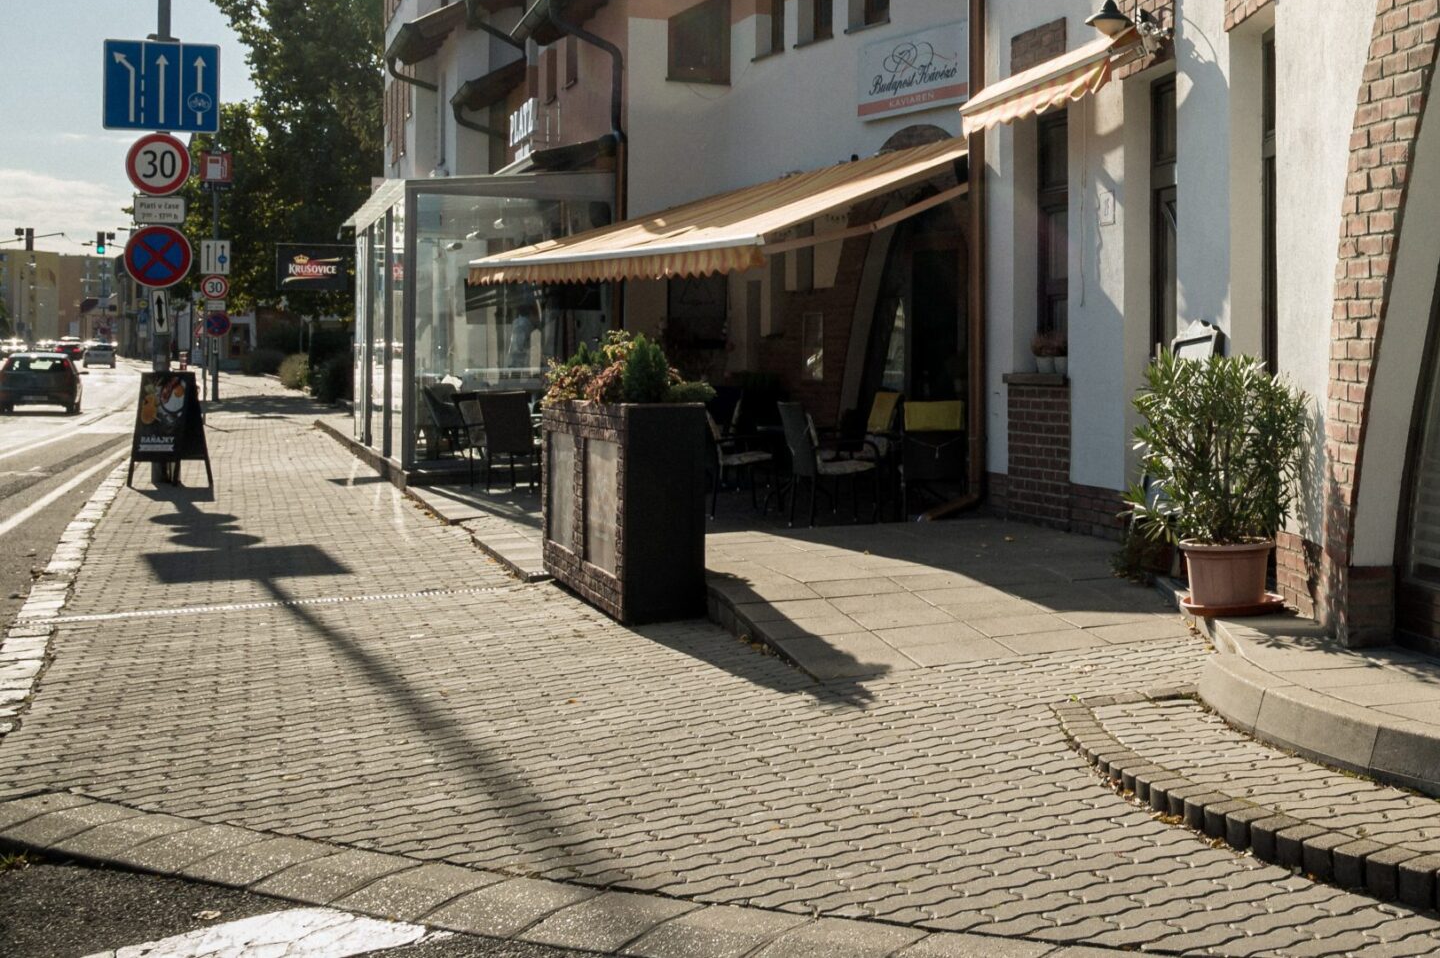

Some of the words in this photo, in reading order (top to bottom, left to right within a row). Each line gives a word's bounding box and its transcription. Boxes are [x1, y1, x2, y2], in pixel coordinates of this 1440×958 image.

[869, 72, 916, 96] Budapest
[142, 150, 176, 178] 30
[208, 282, 222, 292] 30
